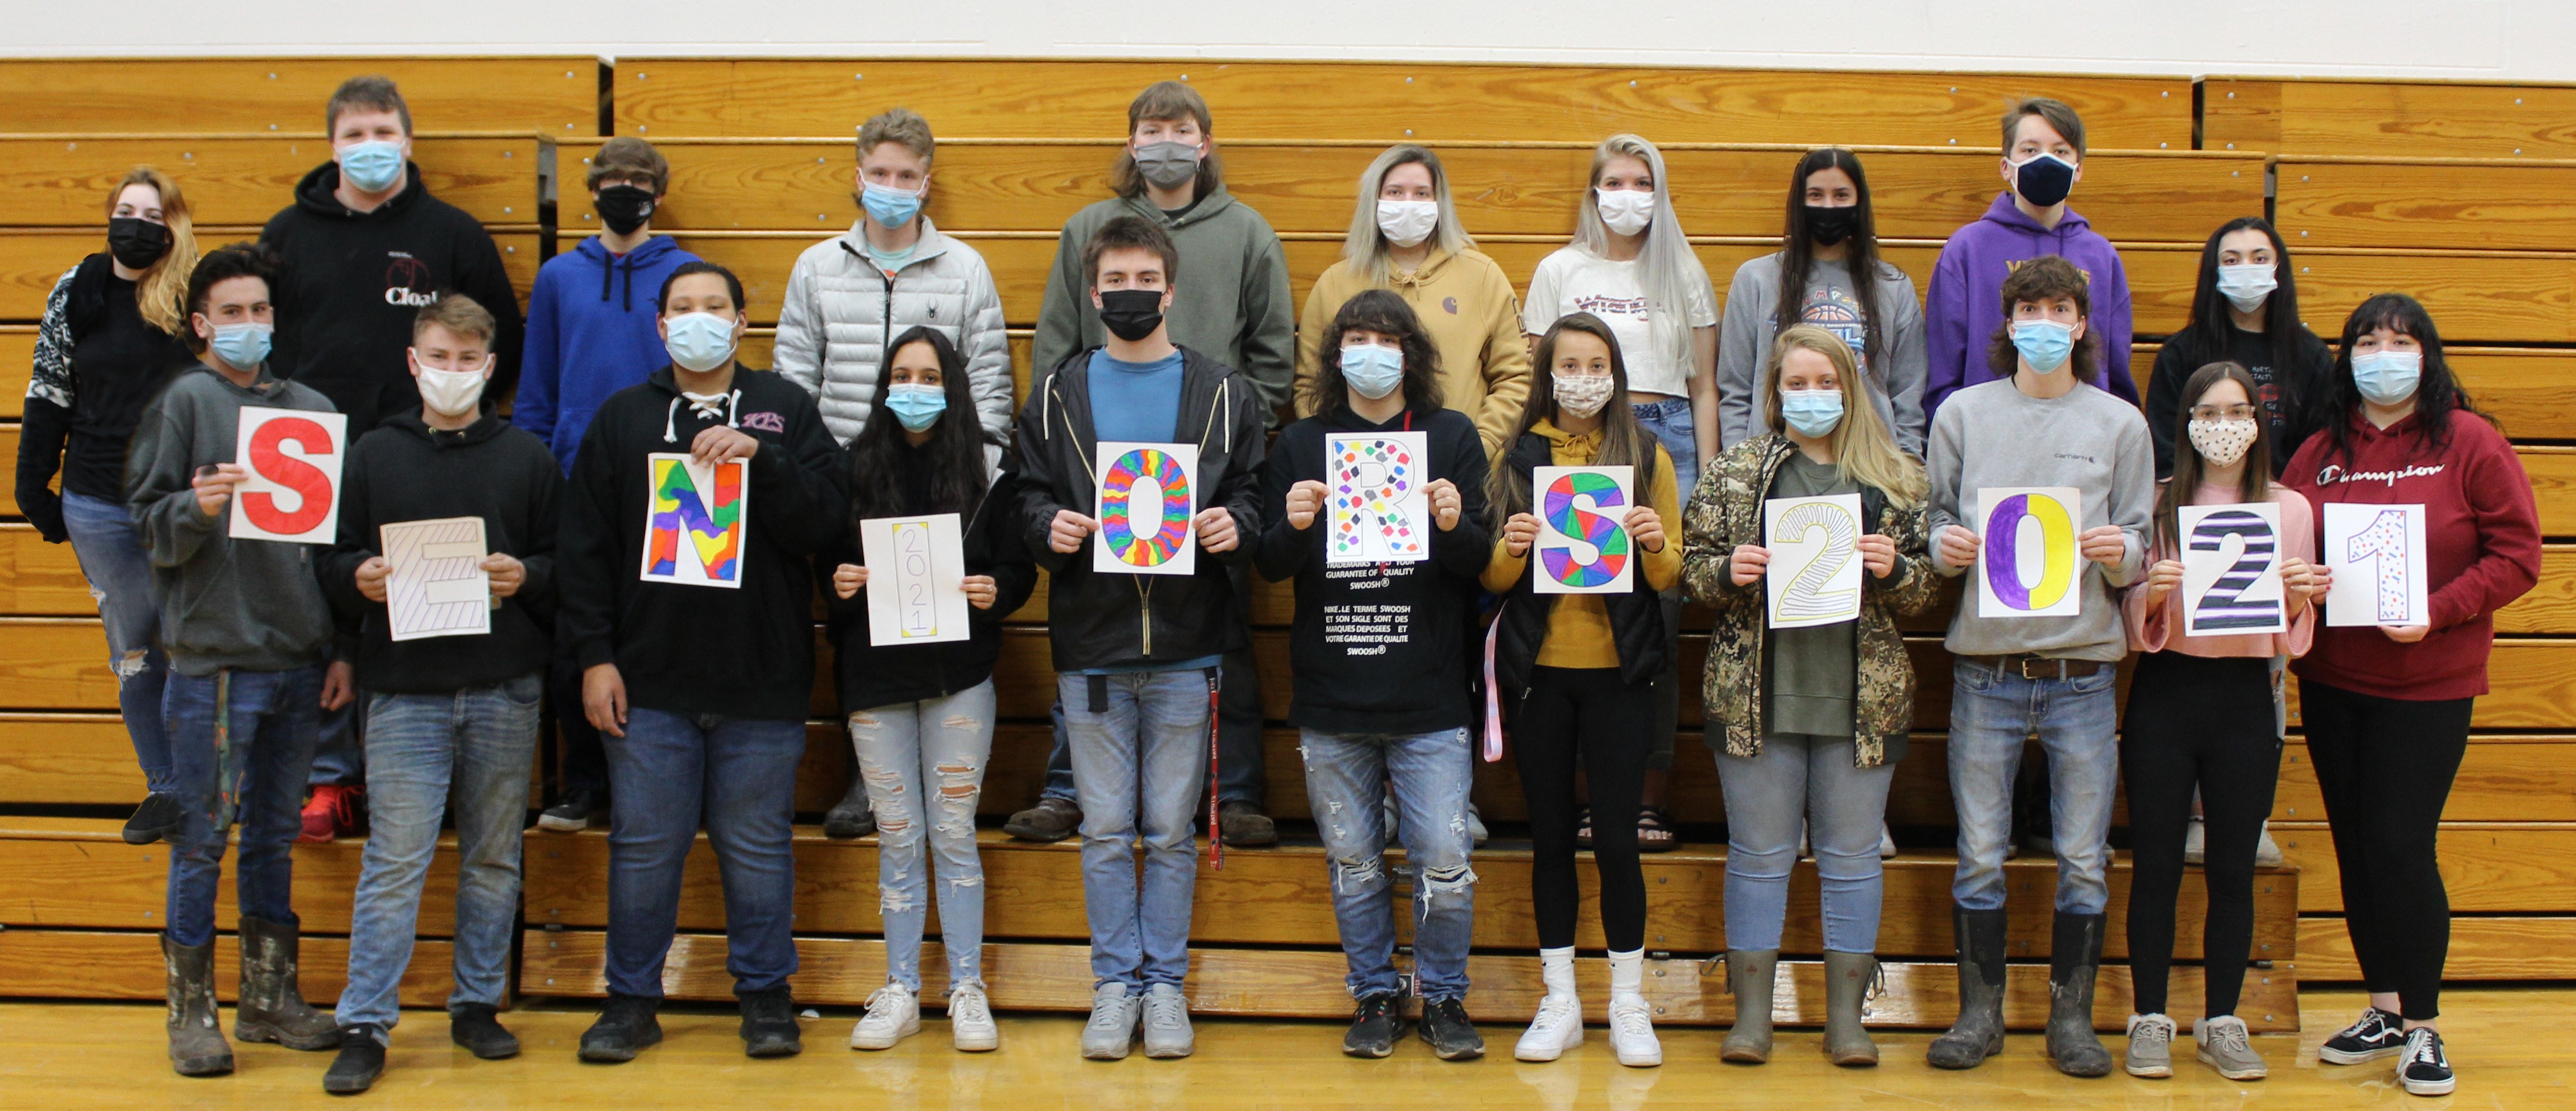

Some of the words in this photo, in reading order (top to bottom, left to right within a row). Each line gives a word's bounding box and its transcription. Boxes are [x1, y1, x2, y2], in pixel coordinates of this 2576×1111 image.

[1574, 294, 1649, 322] Wrang
[241, 416, 333, 535] S
[648, 459, 740, 581] N
[1332, 439, 1424, 556] R
[1541, 472, 1629, 587] S
[2317, 465, 2445, 487] Champion
[387, 522, 483, 634] E
[1326, 570, 1367, 578] GUARANTEE
[1383, 568, 1414, 576] QUALITY
[1774, 502, 1857, 622] 2
[2190, 510, 2280, 630] 2
[2348, 510, 2410, 621] 1
